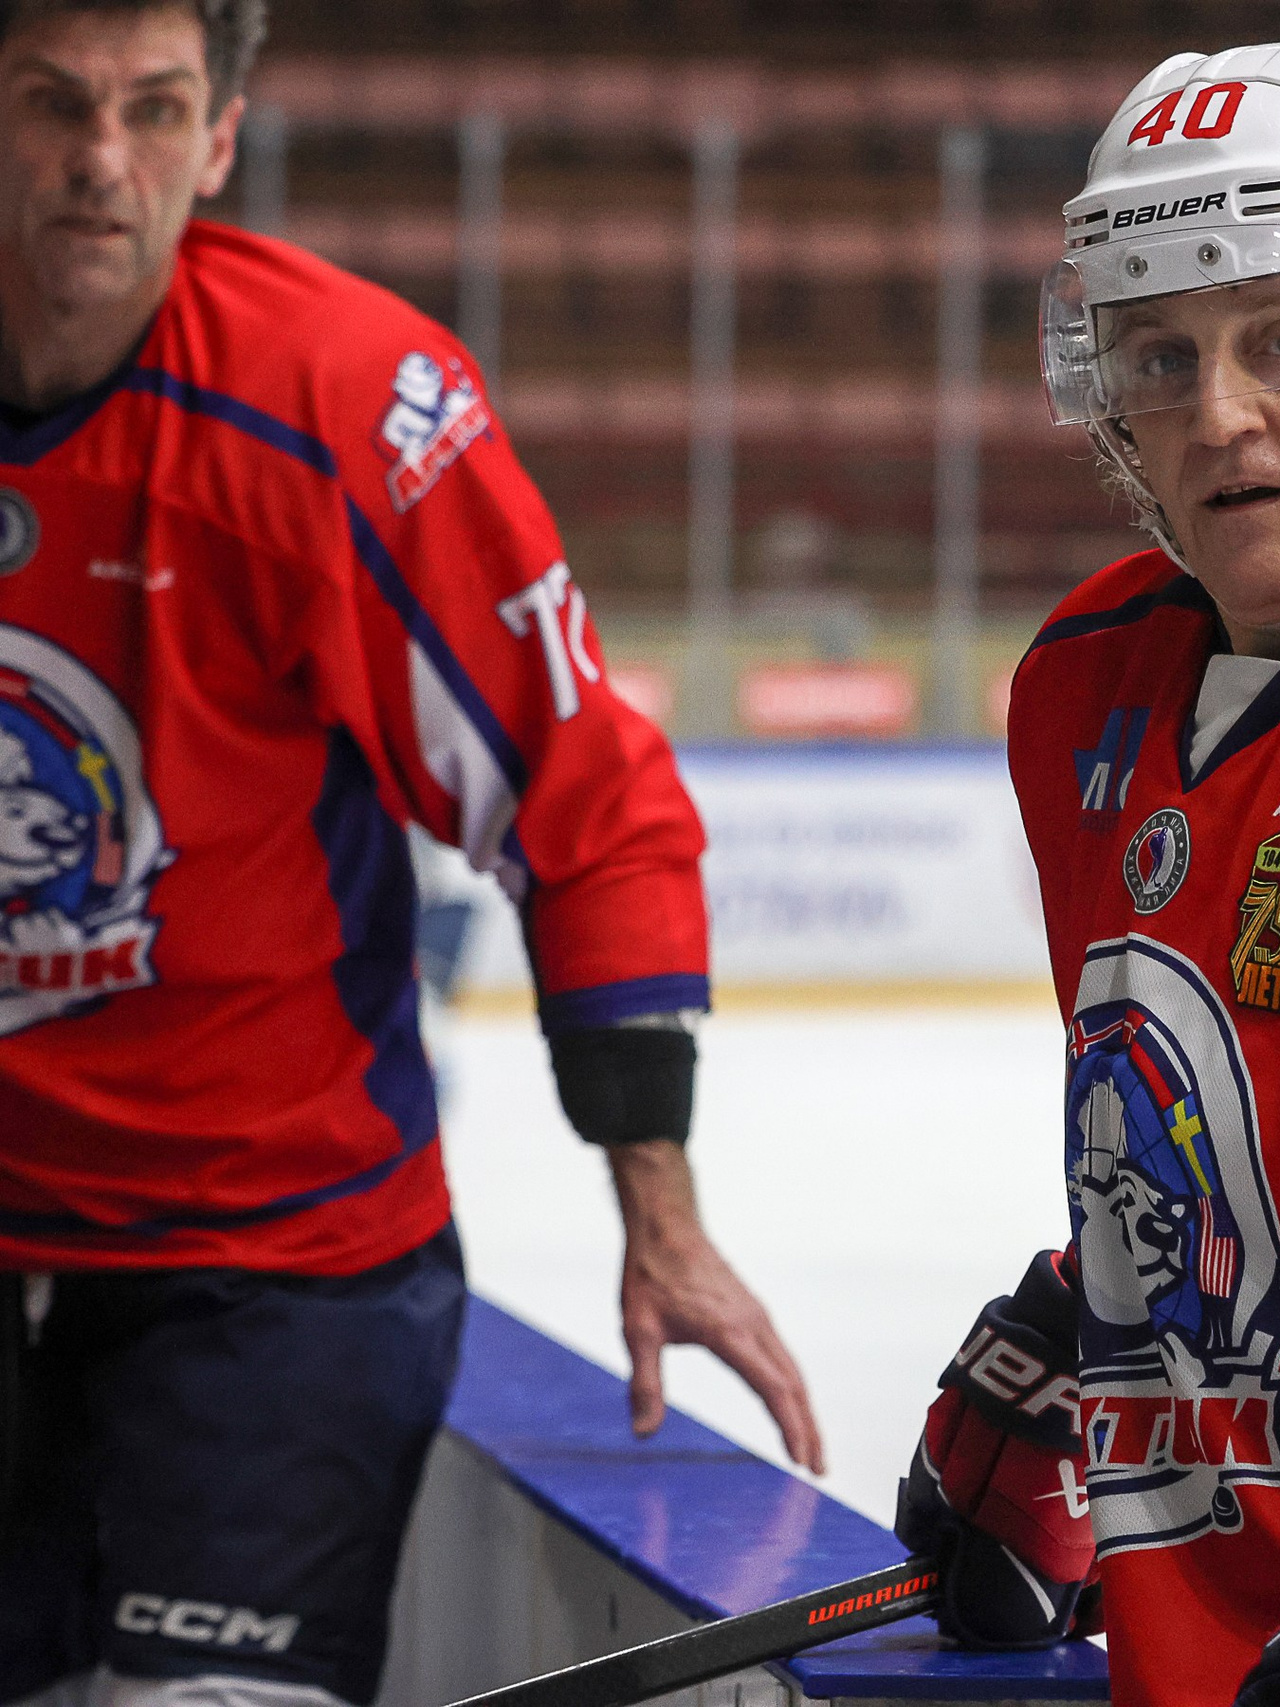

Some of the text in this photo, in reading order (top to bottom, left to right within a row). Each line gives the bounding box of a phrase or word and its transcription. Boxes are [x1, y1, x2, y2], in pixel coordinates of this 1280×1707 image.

[1127, 81, 1248, 147] 40
[1112, 192, 1228, 230] BAUER
[113, 1592, 301, 1652] CCM
[808, 1572, 939, 1625] WARRIOR
